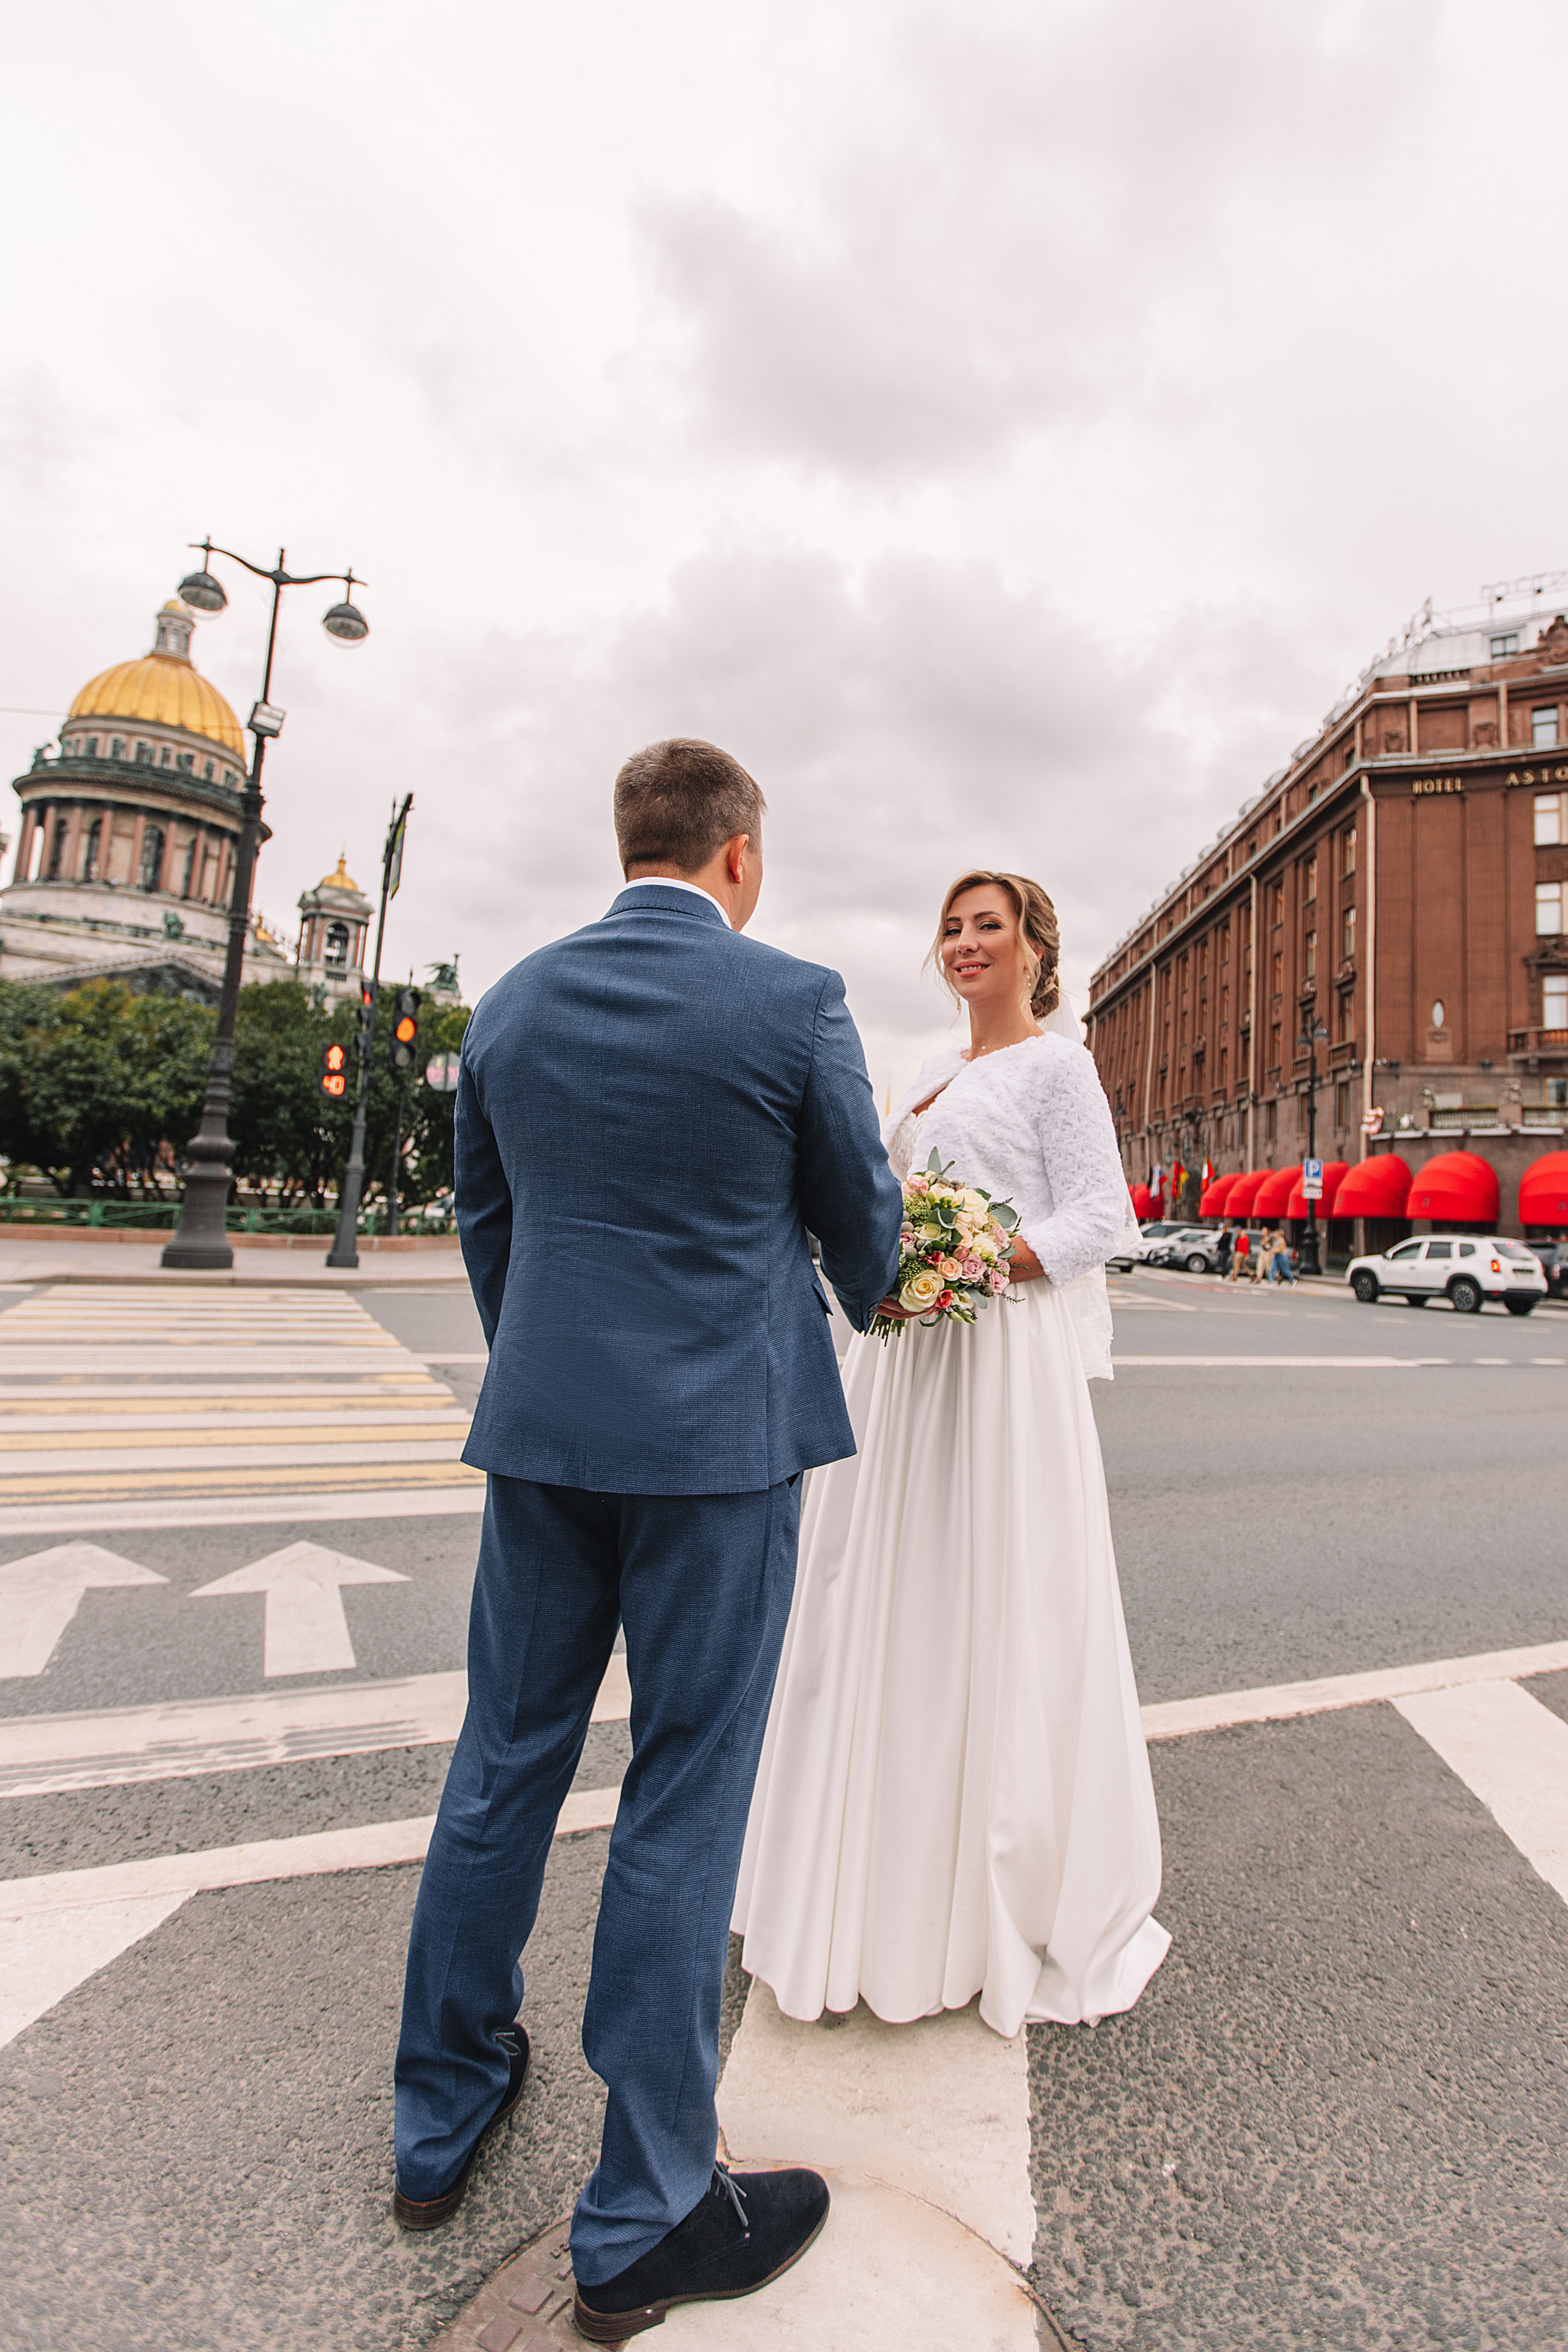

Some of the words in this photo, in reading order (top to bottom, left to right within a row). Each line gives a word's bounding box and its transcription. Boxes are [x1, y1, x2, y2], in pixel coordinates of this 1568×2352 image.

[1412, 776, 1464, 794] HOTEL
[1505, 766, 1568, 787] ASTO
[323, 1075, 345, 1095] 40
[1308, 1159, 1320, 1177] P
